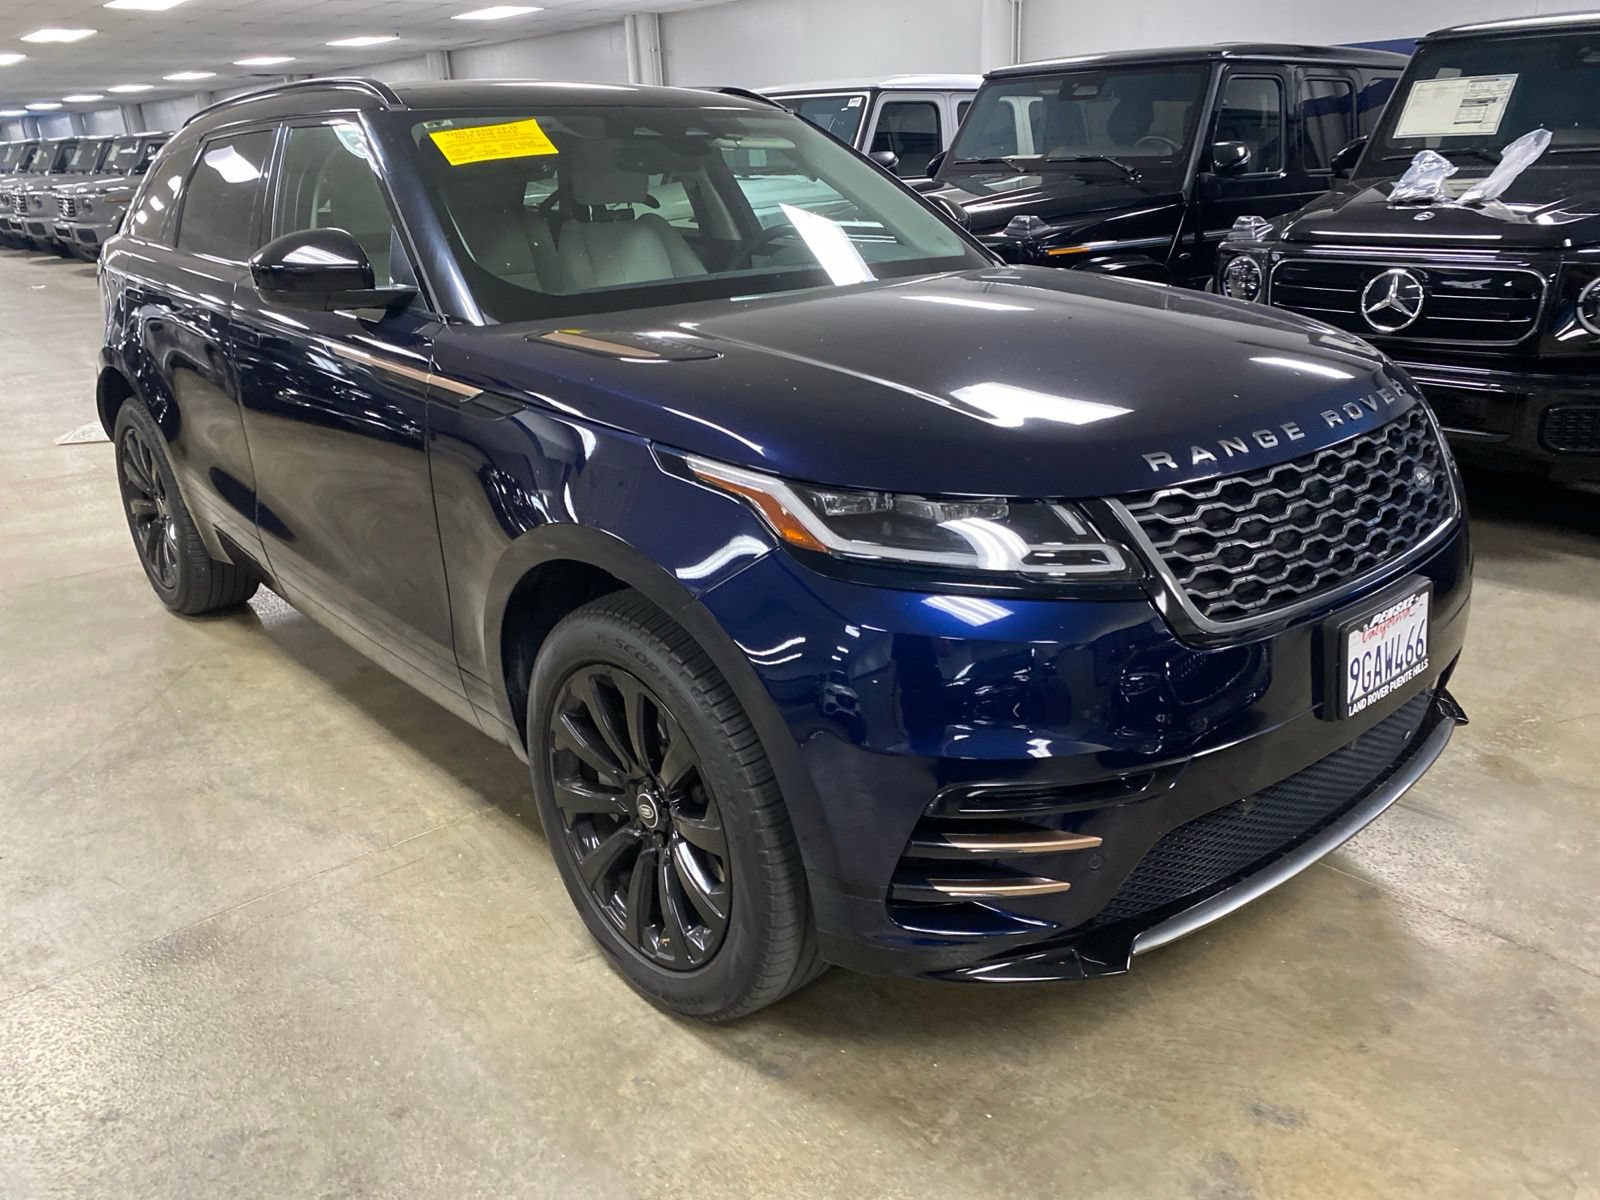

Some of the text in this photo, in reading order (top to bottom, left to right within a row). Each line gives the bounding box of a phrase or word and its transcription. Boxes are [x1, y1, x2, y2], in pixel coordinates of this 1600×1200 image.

[1141, 378, 1407, 472] RANGE ROVER
[1369, 594, 1416, 627] PENSKE
[1348, 658, 1429, 717] LAND ROVER PUENTE HILLS
[1350, 619, 1425, 701] 9GAW466
